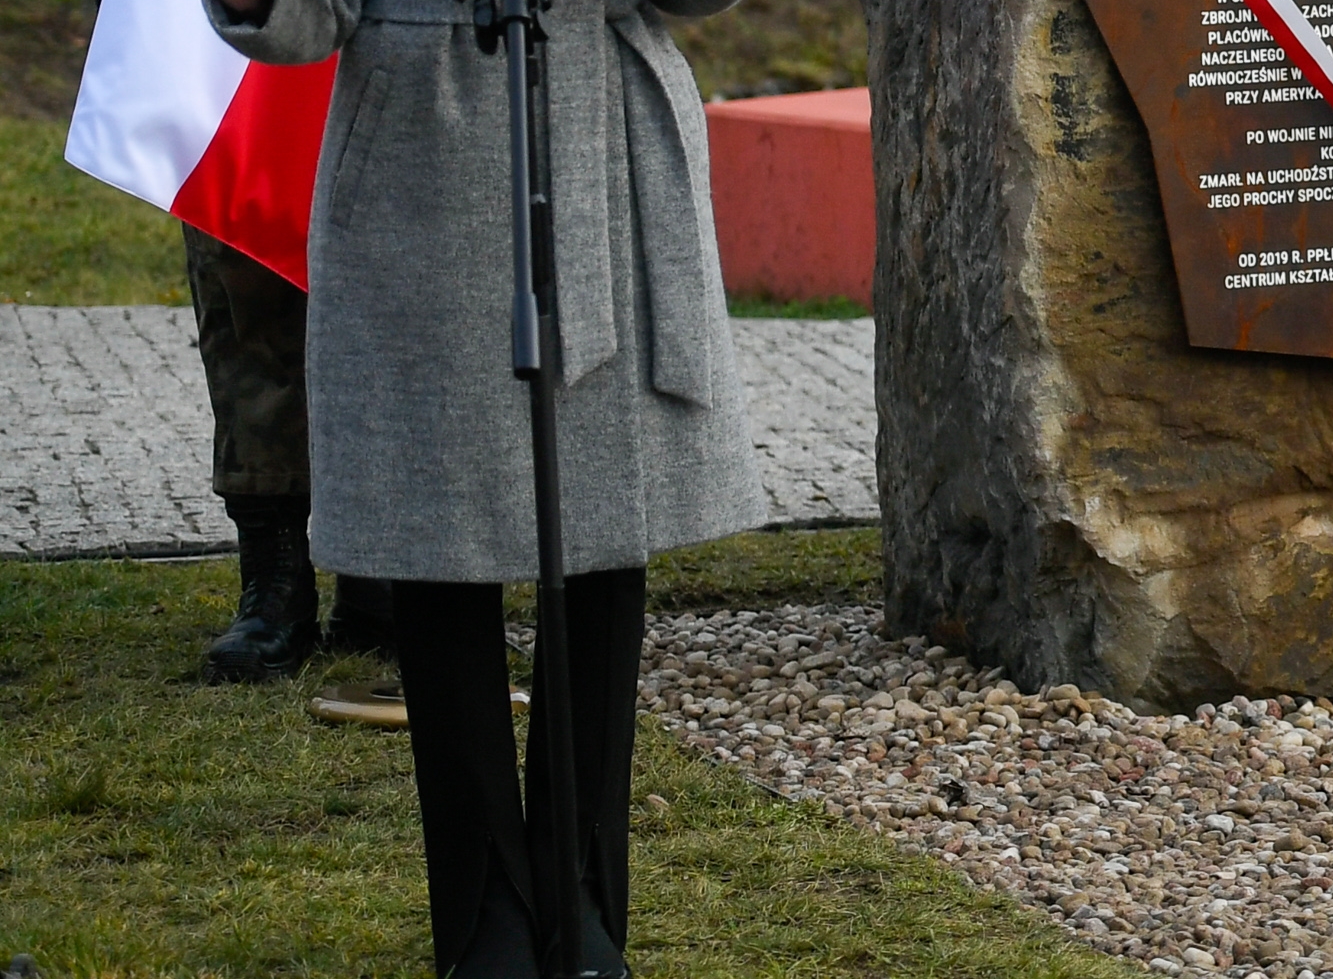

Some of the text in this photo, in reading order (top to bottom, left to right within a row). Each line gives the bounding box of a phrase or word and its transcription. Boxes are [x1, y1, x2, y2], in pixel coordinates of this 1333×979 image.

[1201, 9, 1258, 25] ZBROJN
[1201, 48, 1285, 65] NACZELNEGO
[1189, 66, 1287, 87] RÓWNOCZEŚNIE
[1291, 68, 1302, 80] W
[1226, 90, 1258, 105] PRZY
[1247, 131, 1263, 144] PO
[1267, 127, 1315, 143] WOJNIE
[1199, 173, 1243, 188] ZMARŁ
[1246, 172, 1264, 185] NA
[1207, 194, 1239, 208] JEGO
[1243, 190, 1294, 205] PROCHY
[1238, 254, 1256, 267] OD
[1259, 251, 1288, 266] 2019
[1292, 251, 1303, 263] R.
[1225, 272, 1285, 288] CENTRUM
